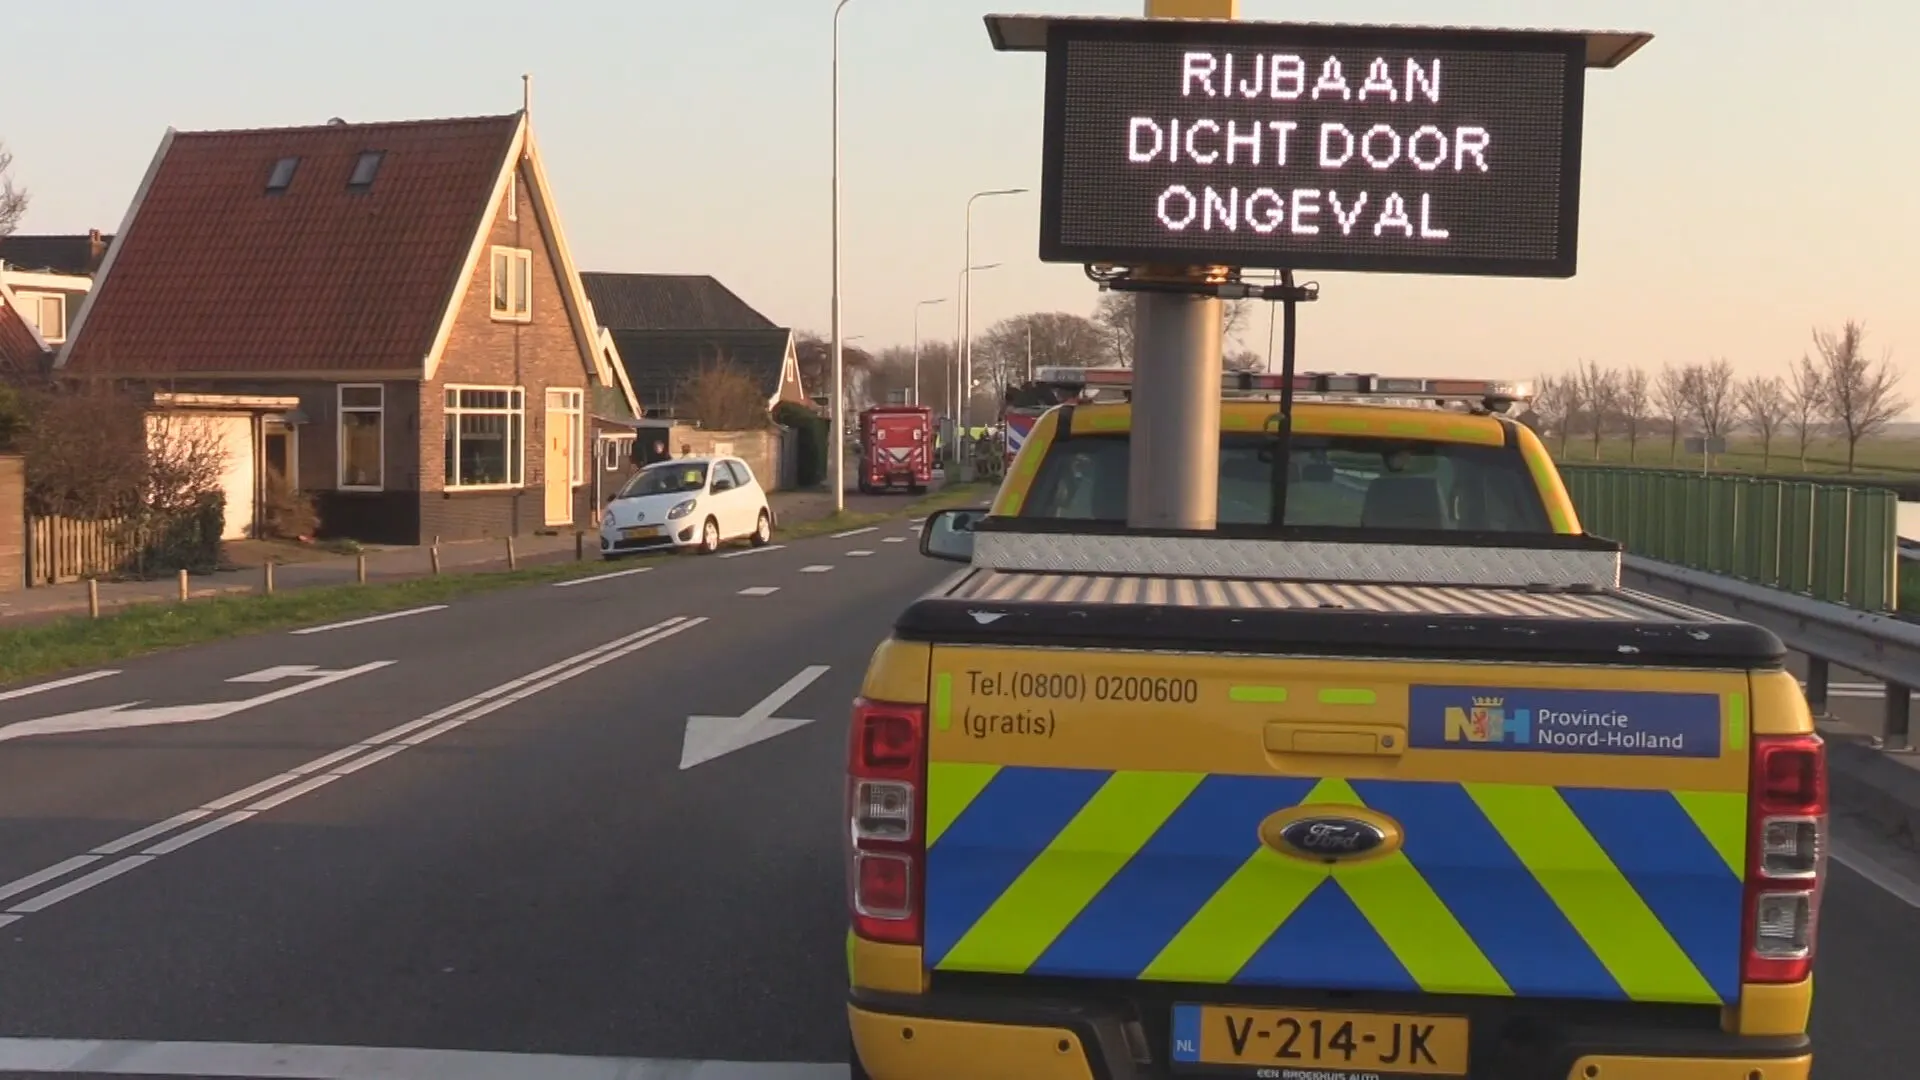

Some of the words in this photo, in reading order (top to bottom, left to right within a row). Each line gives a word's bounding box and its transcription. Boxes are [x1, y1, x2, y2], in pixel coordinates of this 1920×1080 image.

[1182, 52, 1441, 103] RIJBAAN
[1127, 117, 1298, 166] DICHT
[1319, 122, 1490, 172] DOOR
[1157, 184, 1449, 239] ONGEVAL
[966, 671, 1087, 702] Tel.(0800)
[1095, 675, 1198, 704] 0200600
[963, 706, 1056, 738] (gratis)
[1538, 709, 1629, 729] Provincie
[1538, 729, 1684, 750] Noord-Holland
[1303, 822, 1360, 848] Ford
[1176, 1039, 1195, 1053] NL
[1224, 1015, 1438, 1065] V-214-JK
